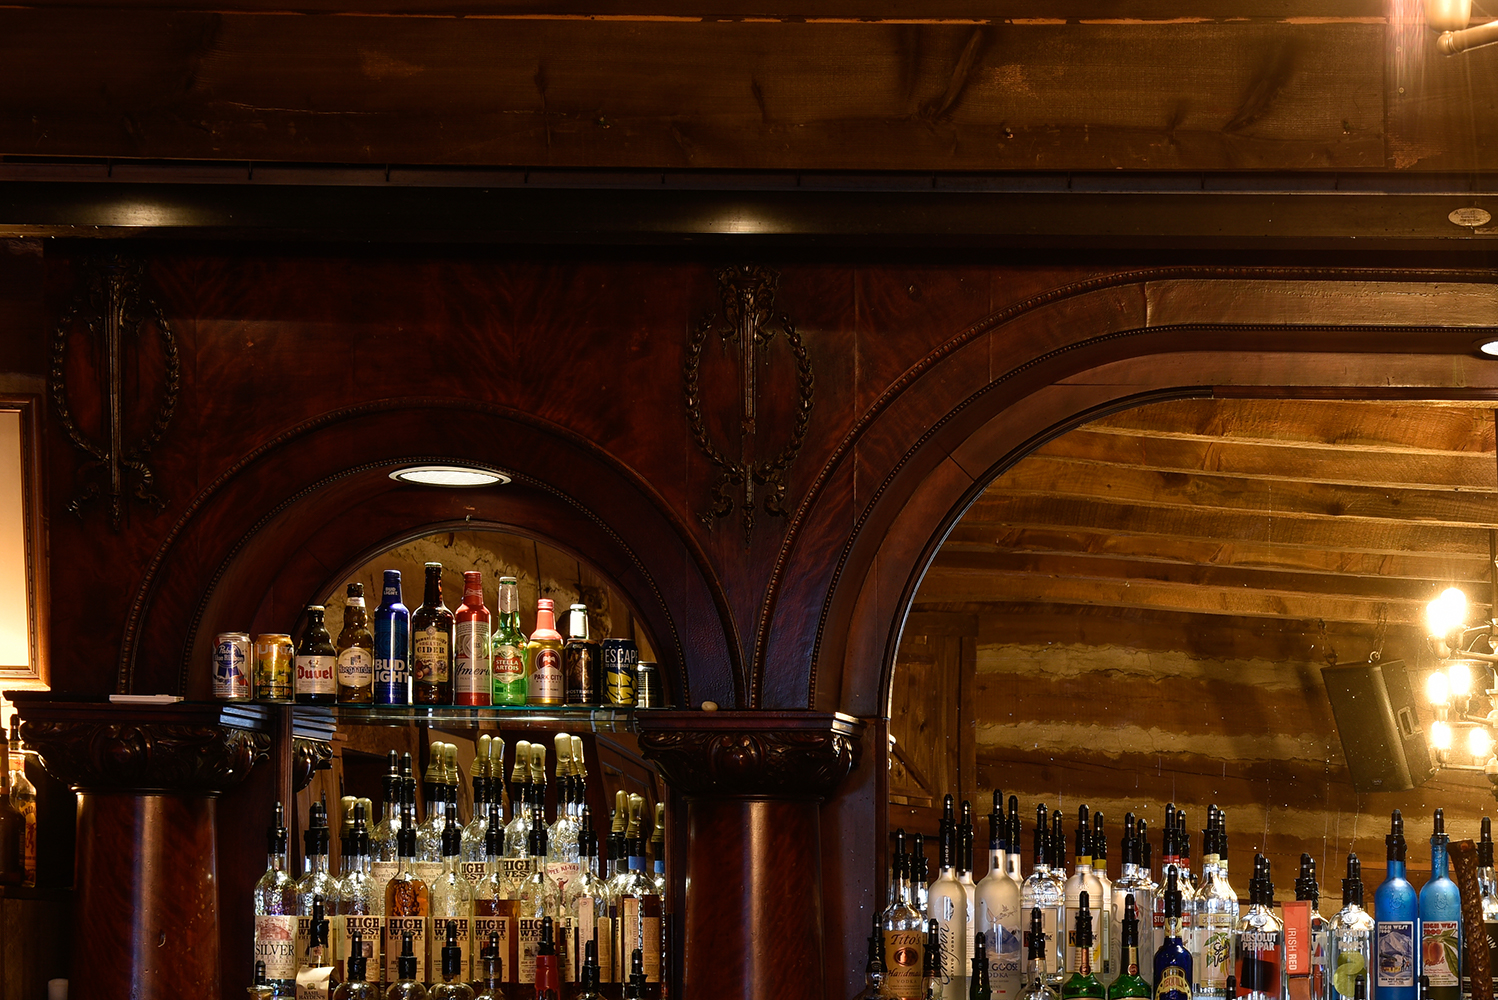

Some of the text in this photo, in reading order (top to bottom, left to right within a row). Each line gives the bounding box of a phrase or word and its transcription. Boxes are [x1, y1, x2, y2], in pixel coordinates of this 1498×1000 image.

[375, 659, 405, 671] BUD
[297, 665, 333, 680] Duvel
[346, 918, 379, 928] HIGH
[389, 919, 422, 928] HIGH
[475, 919, 506, 929] HIGH
[891, 934, 921, 945] Tito's
[1241, 933, 1277, 942] ABSOLUT
[256, 944, 294, 956] SILVER
[1242, 942, 1275, 951] PEPPAR
[1288, 928, 1297, 971] IRISH RED
[991, 963, 1018, 971] GOOSE
